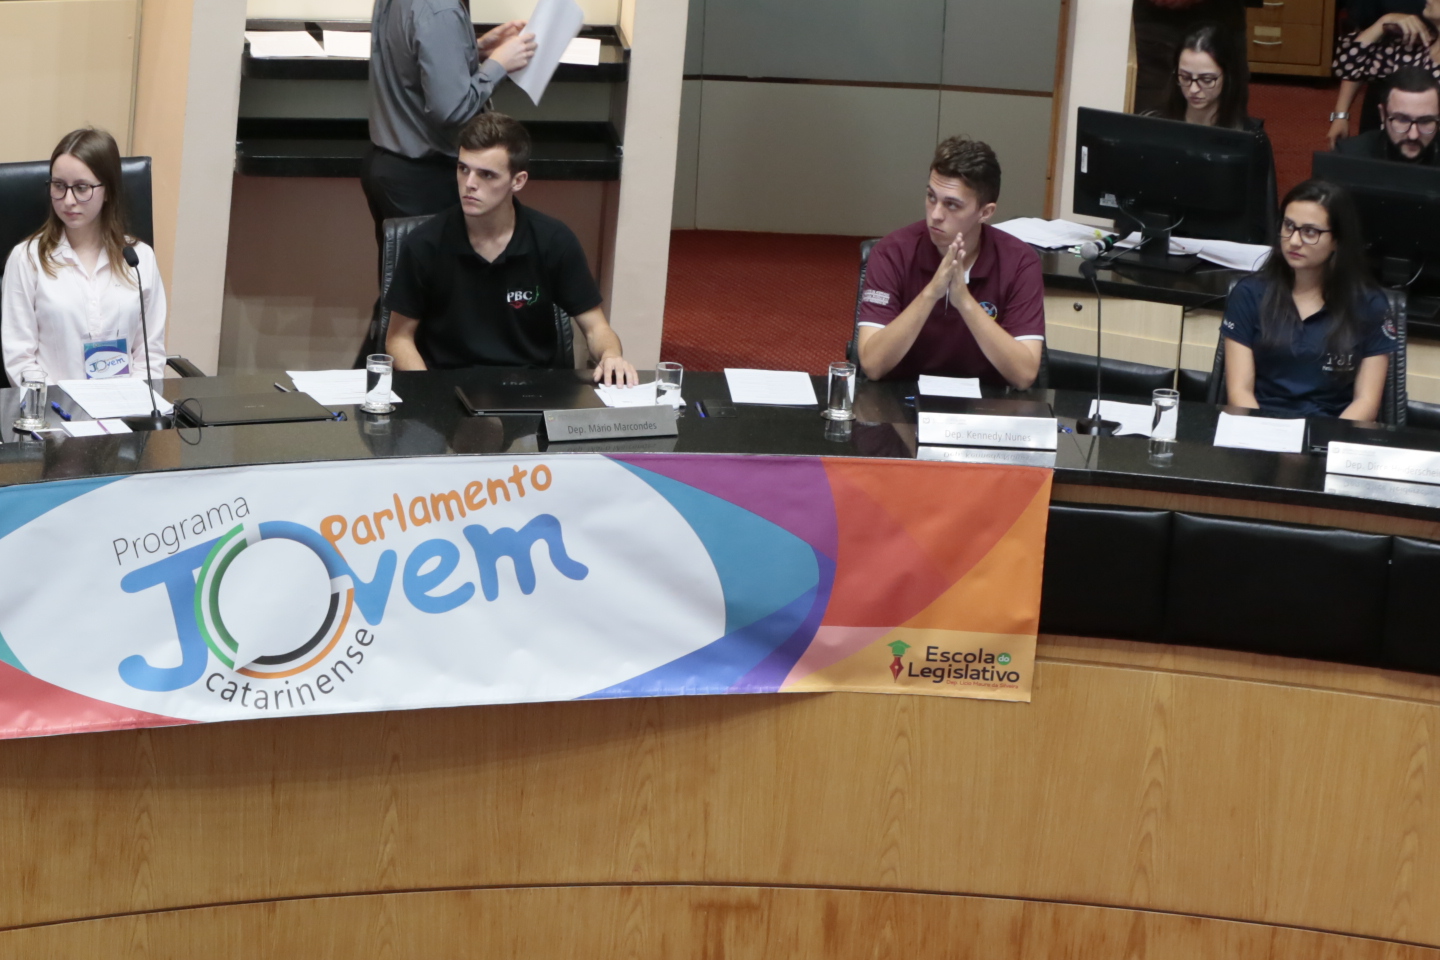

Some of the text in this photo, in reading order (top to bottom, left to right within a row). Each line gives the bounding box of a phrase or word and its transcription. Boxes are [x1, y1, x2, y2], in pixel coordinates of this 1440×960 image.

[506, 290, 533, 303] PBC
[568, 425, 586, 436] Dep.
[613, 421, 658, 432] Marcondes
[945, 430, 1032, 443] Dep. Kennedy Nunes
[1345, 460, 1365, 471] Dep.
[319, 464, 553, 562] Parlamento
[113, 496, 251, 566] Programa
[925, 645, 1011, 665] Escola do
[907, 661, 1020, 684] Legislativo
